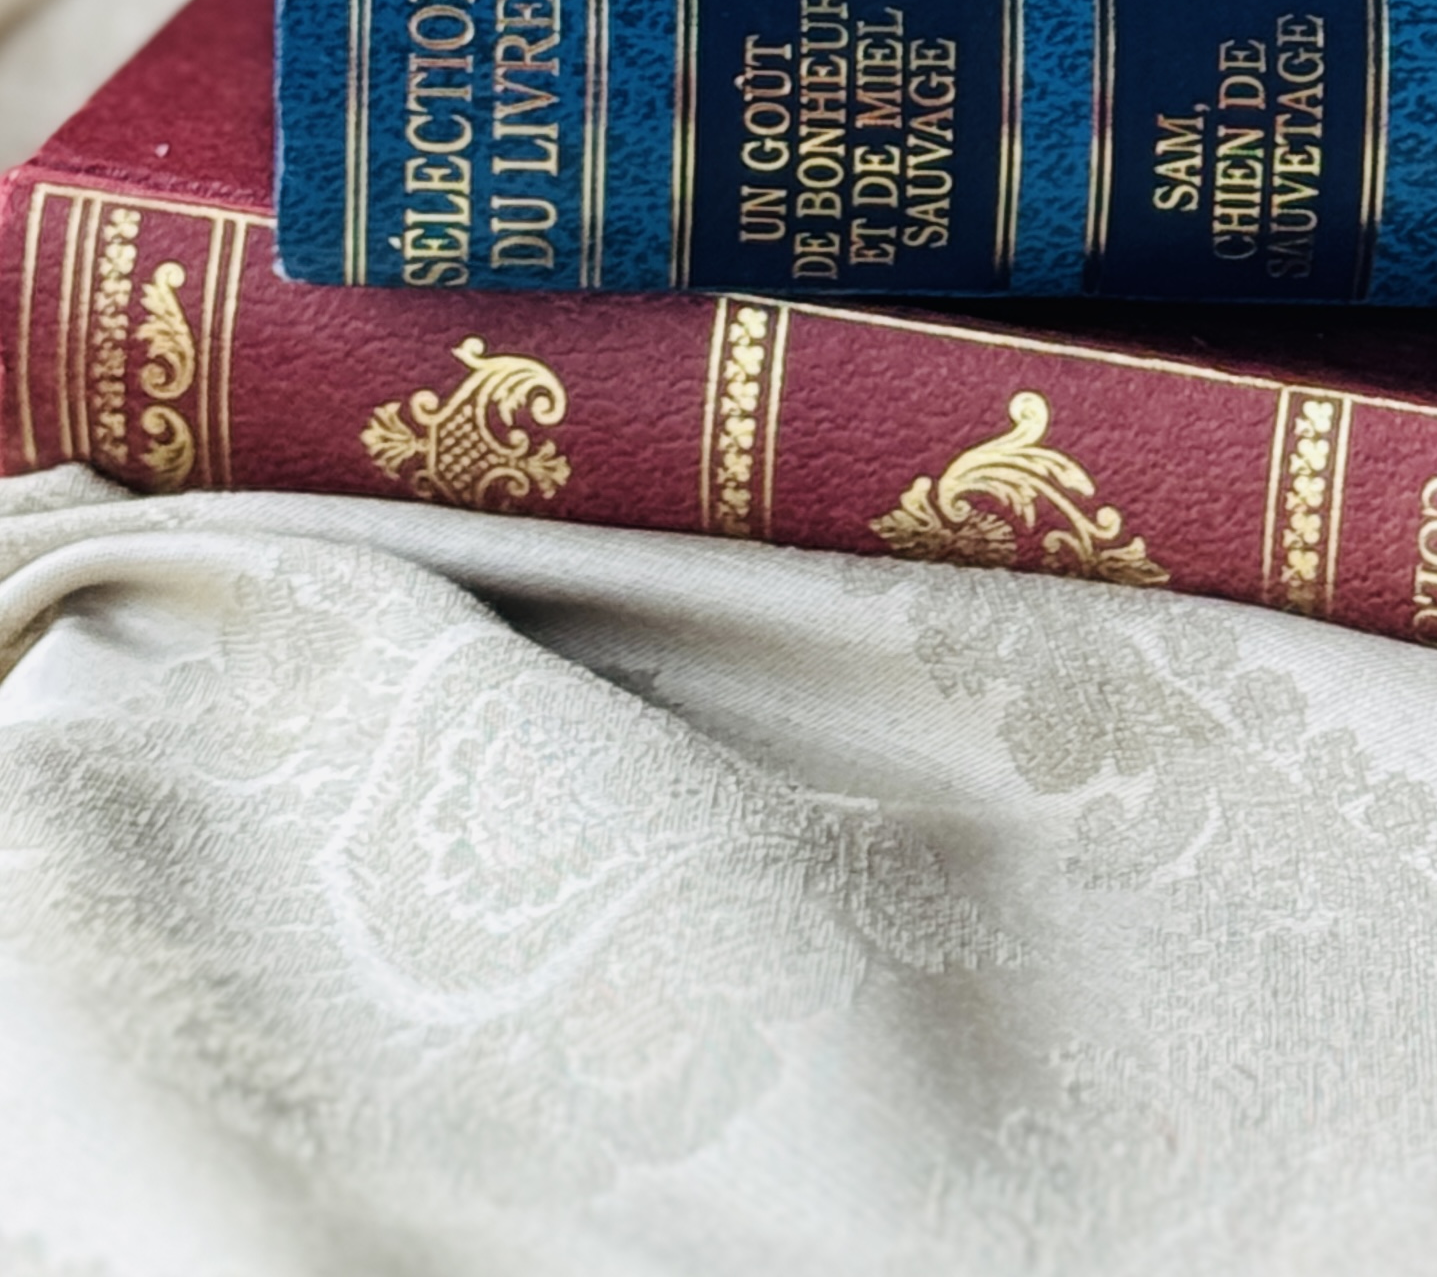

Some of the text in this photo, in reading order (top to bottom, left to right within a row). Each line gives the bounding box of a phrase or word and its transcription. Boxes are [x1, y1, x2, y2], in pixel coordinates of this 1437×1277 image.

[490, 190, 557, 270] DU
[735, 35, 793, 244] UN GOÛT
[848, 6, 904, 266] ET DE MIEL
[902, 38, 957, 248] SAUVAGE
[1152, 102, 1212, 213] SAM,
[1211, 38, 1267, 260] CHIEN DE
[1266, 12, 1325, 280] SAUVETAGE
[792, 232, 840, 280] DE
